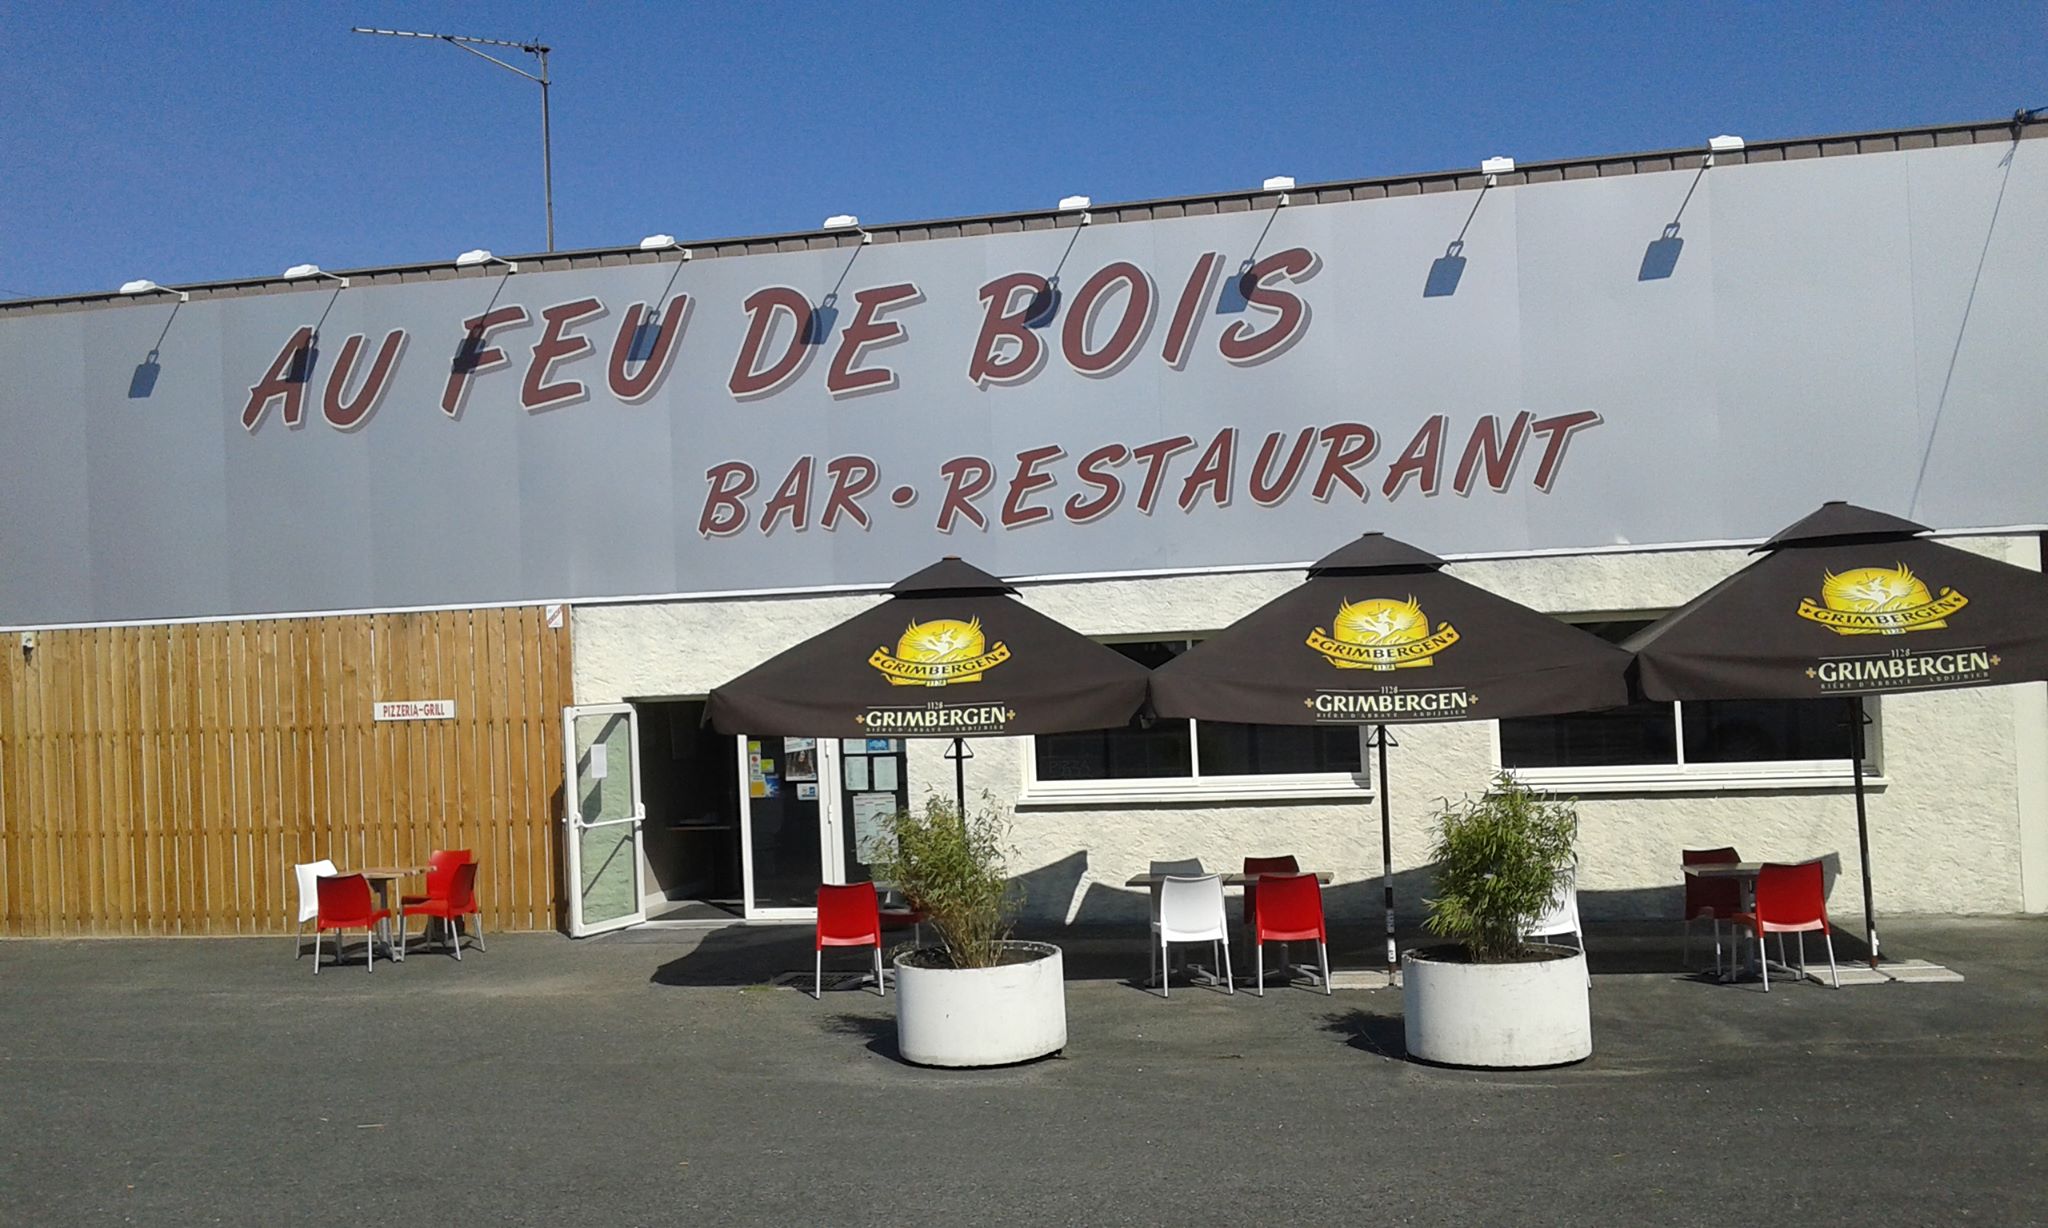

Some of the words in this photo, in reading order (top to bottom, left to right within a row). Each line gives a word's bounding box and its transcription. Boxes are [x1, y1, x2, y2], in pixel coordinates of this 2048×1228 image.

[242, 325, 407, 431] AU
[441, 294, 692, 418] FEU
[727, 281, 924, 398] DE
[968, 246, 1320, 386] BOIS
[1813, 598, 1957, 625] GRIMBERGEN
[1319, 635, 1448, 659] GRIMBERGEN
[1890, 648, 1911, 658] 1128
[880, 653, 999, 675] GRIMBERGEN
[1817, 651, 1990, 682] GRIMBERGEN
[1381, 685, 1398, 695] 1128
[383, 702, 445, 718] PIZZERIA-GRILL
[926, 701, 944, 711] 1128
[1315, 691, 1468, 713] GRIMBERGEN
[866, 707, 1006, 727] GRIMBERGEN
